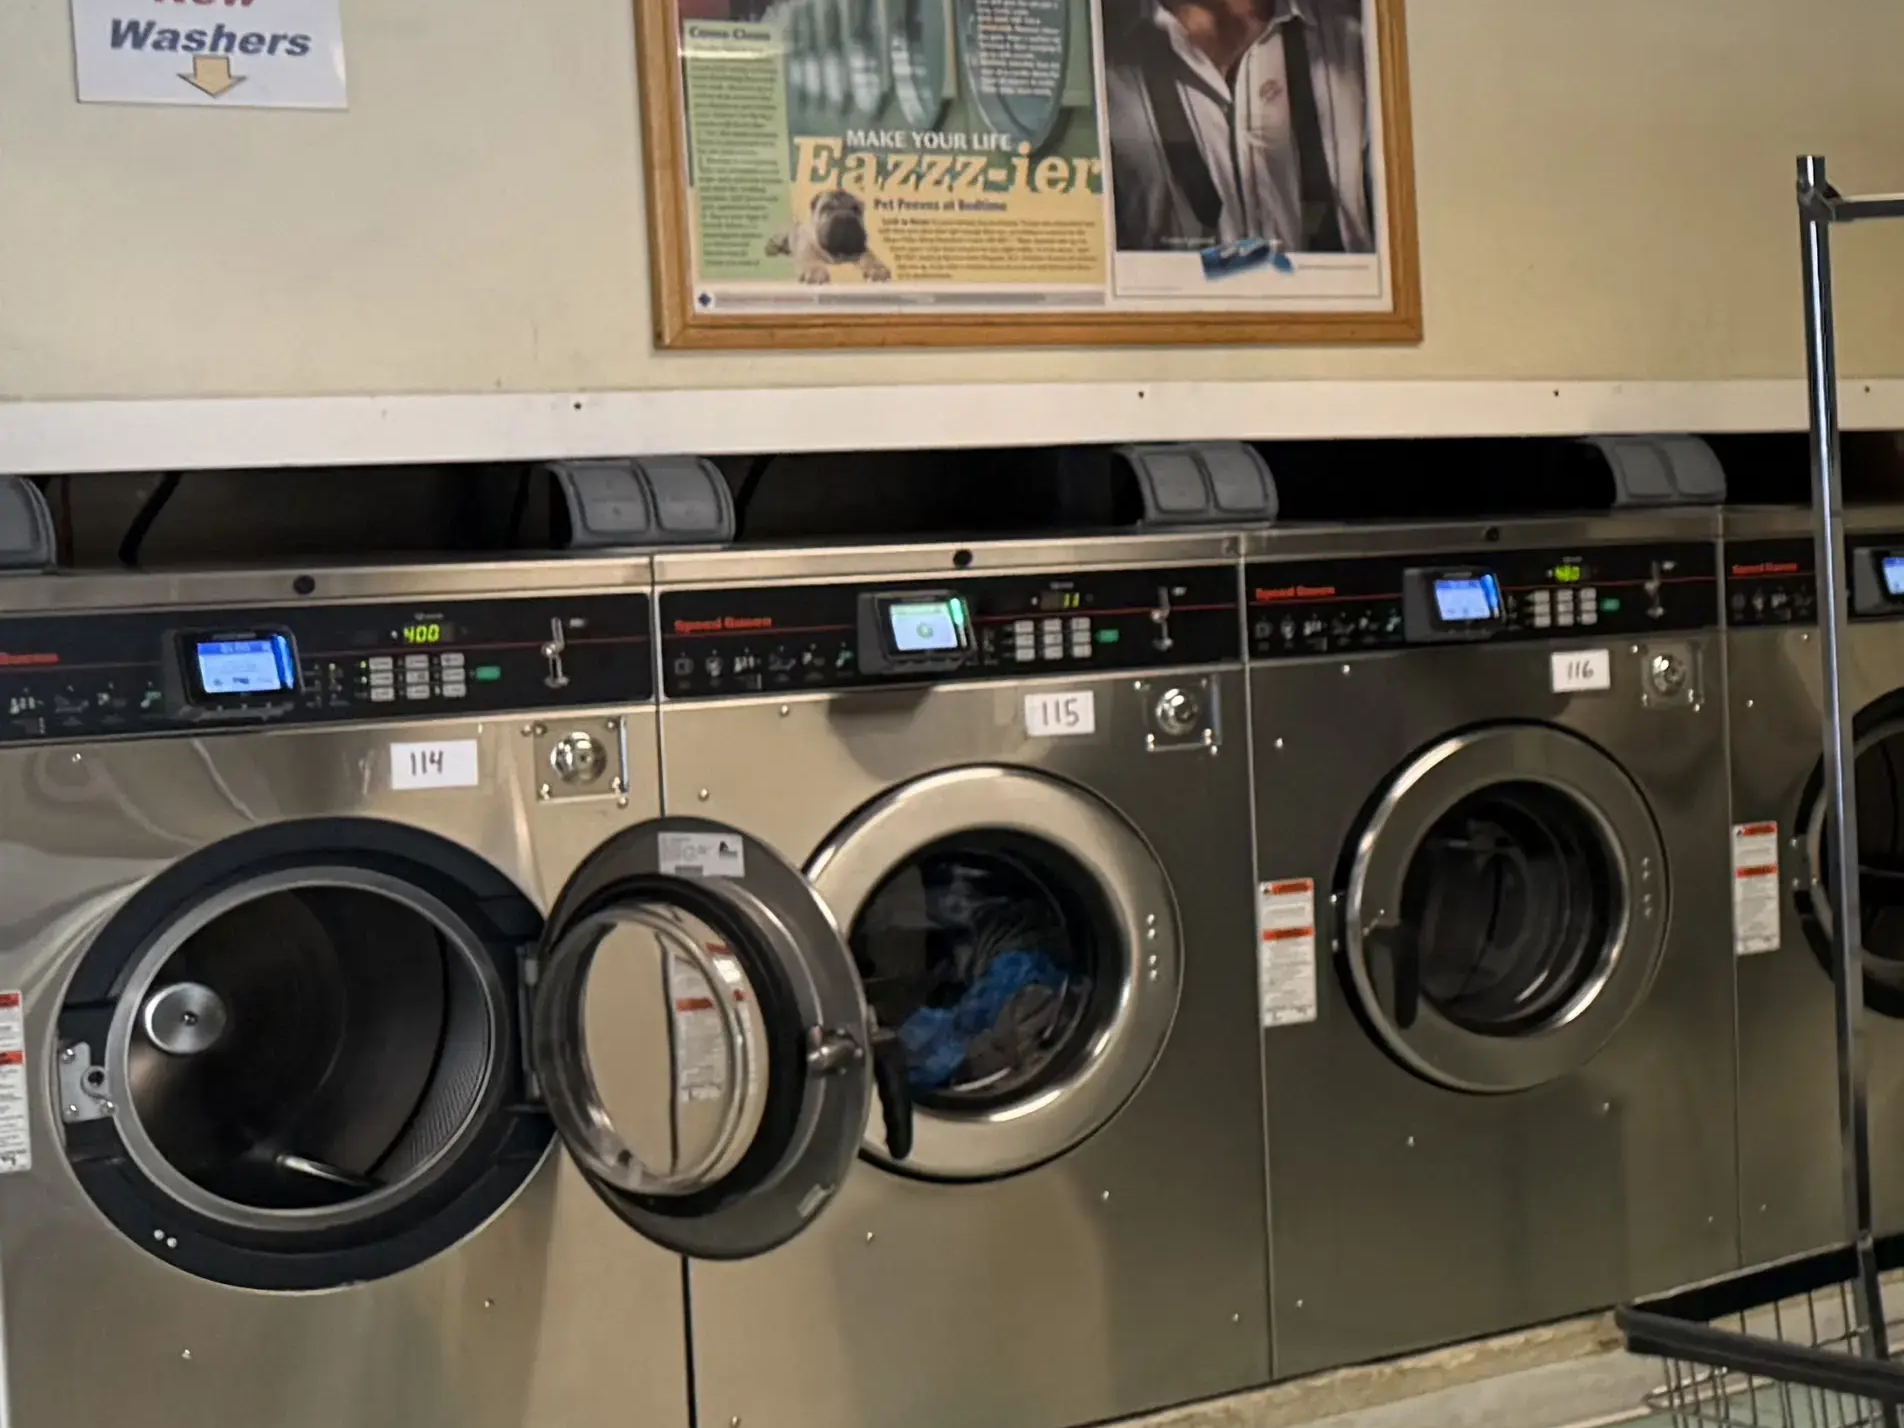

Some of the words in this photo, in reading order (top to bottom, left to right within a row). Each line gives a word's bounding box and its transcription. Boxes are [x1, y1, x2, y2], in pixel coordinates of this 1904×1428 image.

[109, 17, 313, 58] Washers
[845, 128, 907, 149] MAKE
[911, 130, 968, 151] YOUR
[972, 132, 1015, 152] LIFE
[791, 134, 1104, 195] Eazzz-ier
[1566, 659, 1595, 681] 116
[1041, 697, 1081, 728] 115
[408, 747, 445, 777] 114
